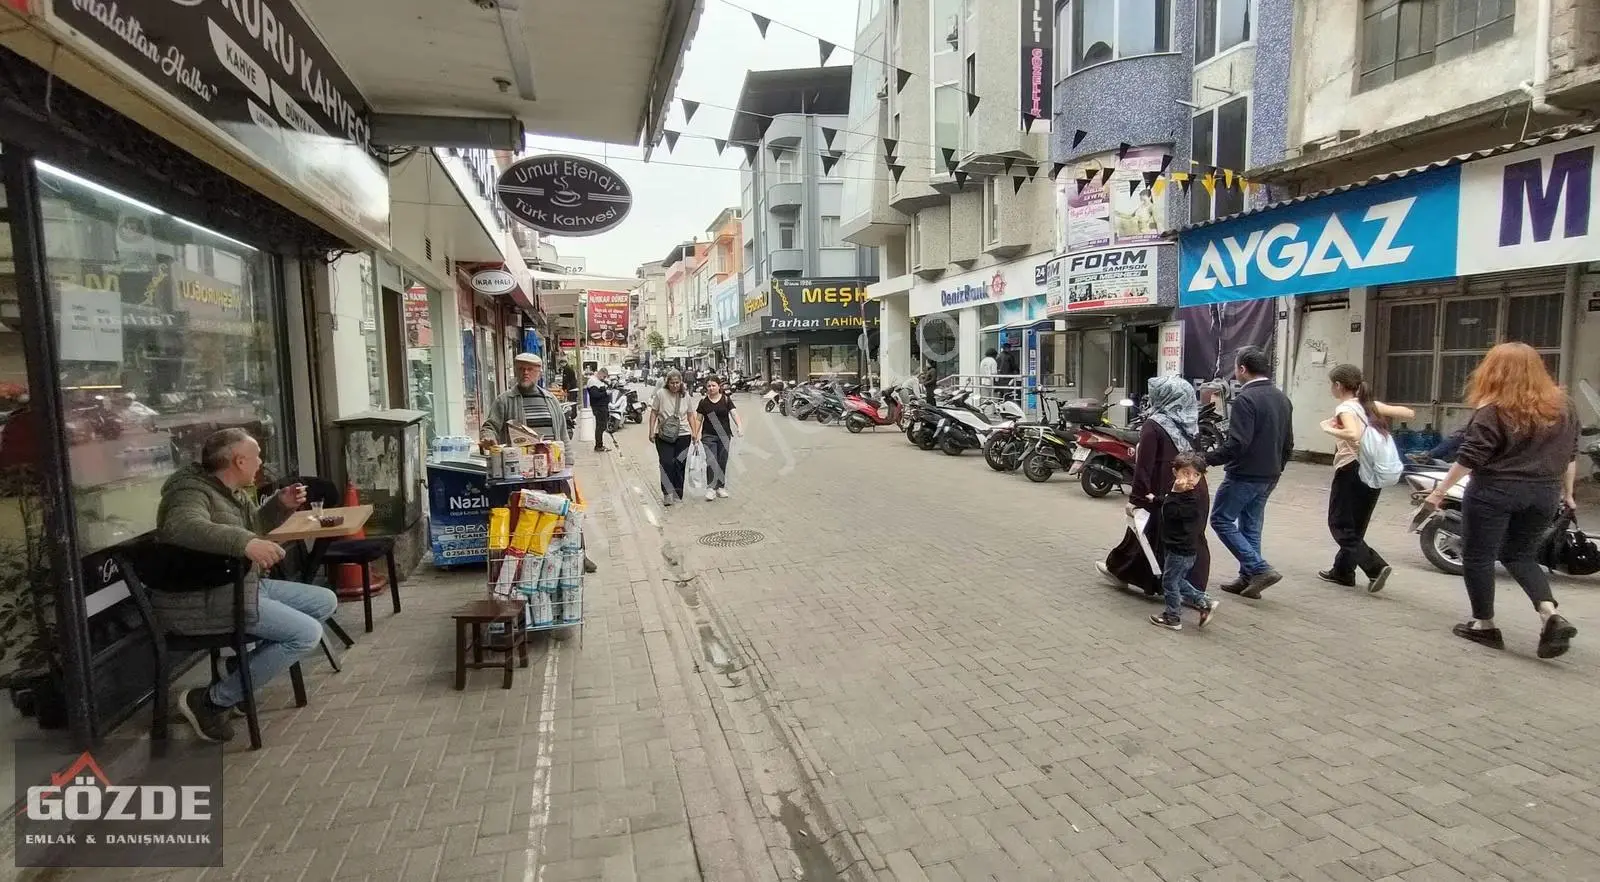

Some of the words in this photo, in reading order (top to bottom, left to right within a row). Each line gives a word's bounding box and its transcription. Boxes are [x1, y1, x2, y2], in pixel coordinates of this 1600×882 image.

[70, 0, 160, 63] malattan
[225, 43, 257, 86] KAHVE
[515, 162, 559, 184] Umut
[564, 160, 615, 192] Efendi
[515, 197, 548, 222] Türk
[552, 205, 617, 226] Kahvesi
[1188, 196, 1417, 292] AYGAZ
[1498, 146, 1596, 248] M
[1070, 249, 1148, 272] FORM
[1102, 264, 1148, 272] SAMPSON
[941, 280, 989, 307] DenizBank
[769, 317, 820, 328] Tarhan
[823, 315, 863, 328] TAHİN
[450, 494, 489, 510] Nazlı
